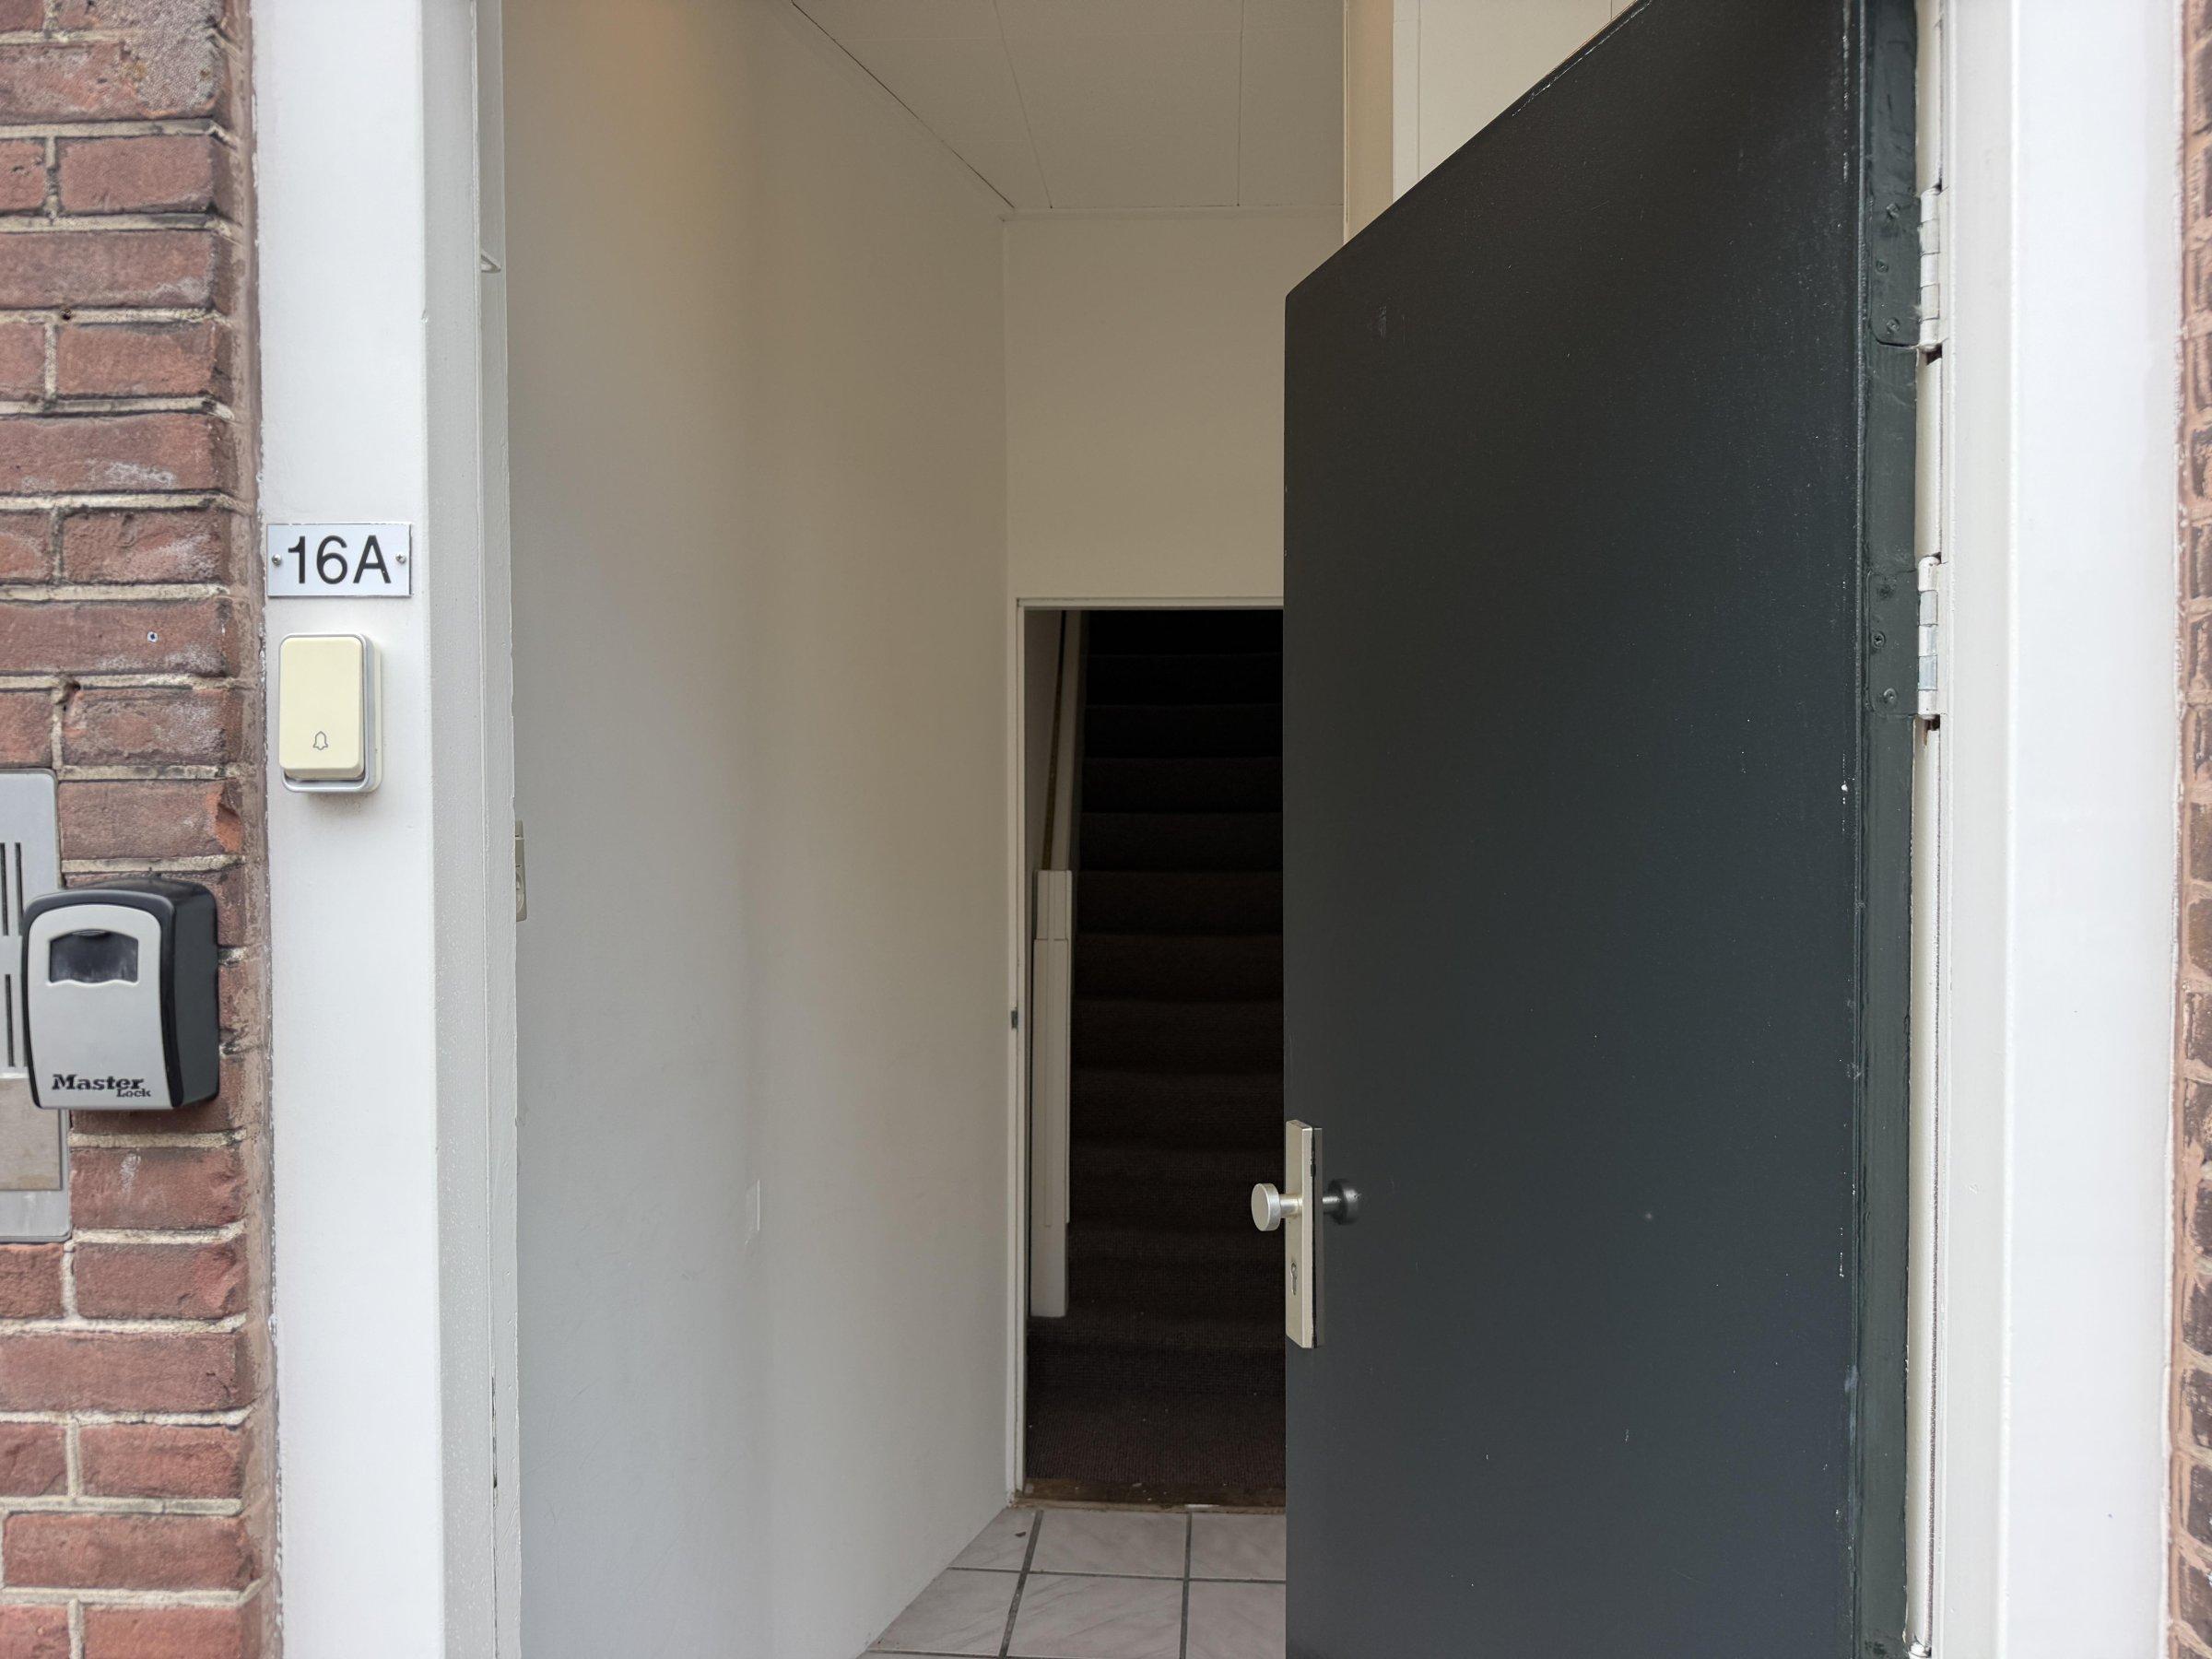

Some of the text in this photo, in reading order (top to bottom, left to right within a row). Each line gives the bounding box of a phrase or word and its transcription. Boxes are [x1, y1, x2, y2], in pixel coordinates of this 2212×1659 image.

[288, 535, 392, 584] 16A
[52, 1074, 145, 1090] Master
[116, 1088, 151, 1098] Lock
